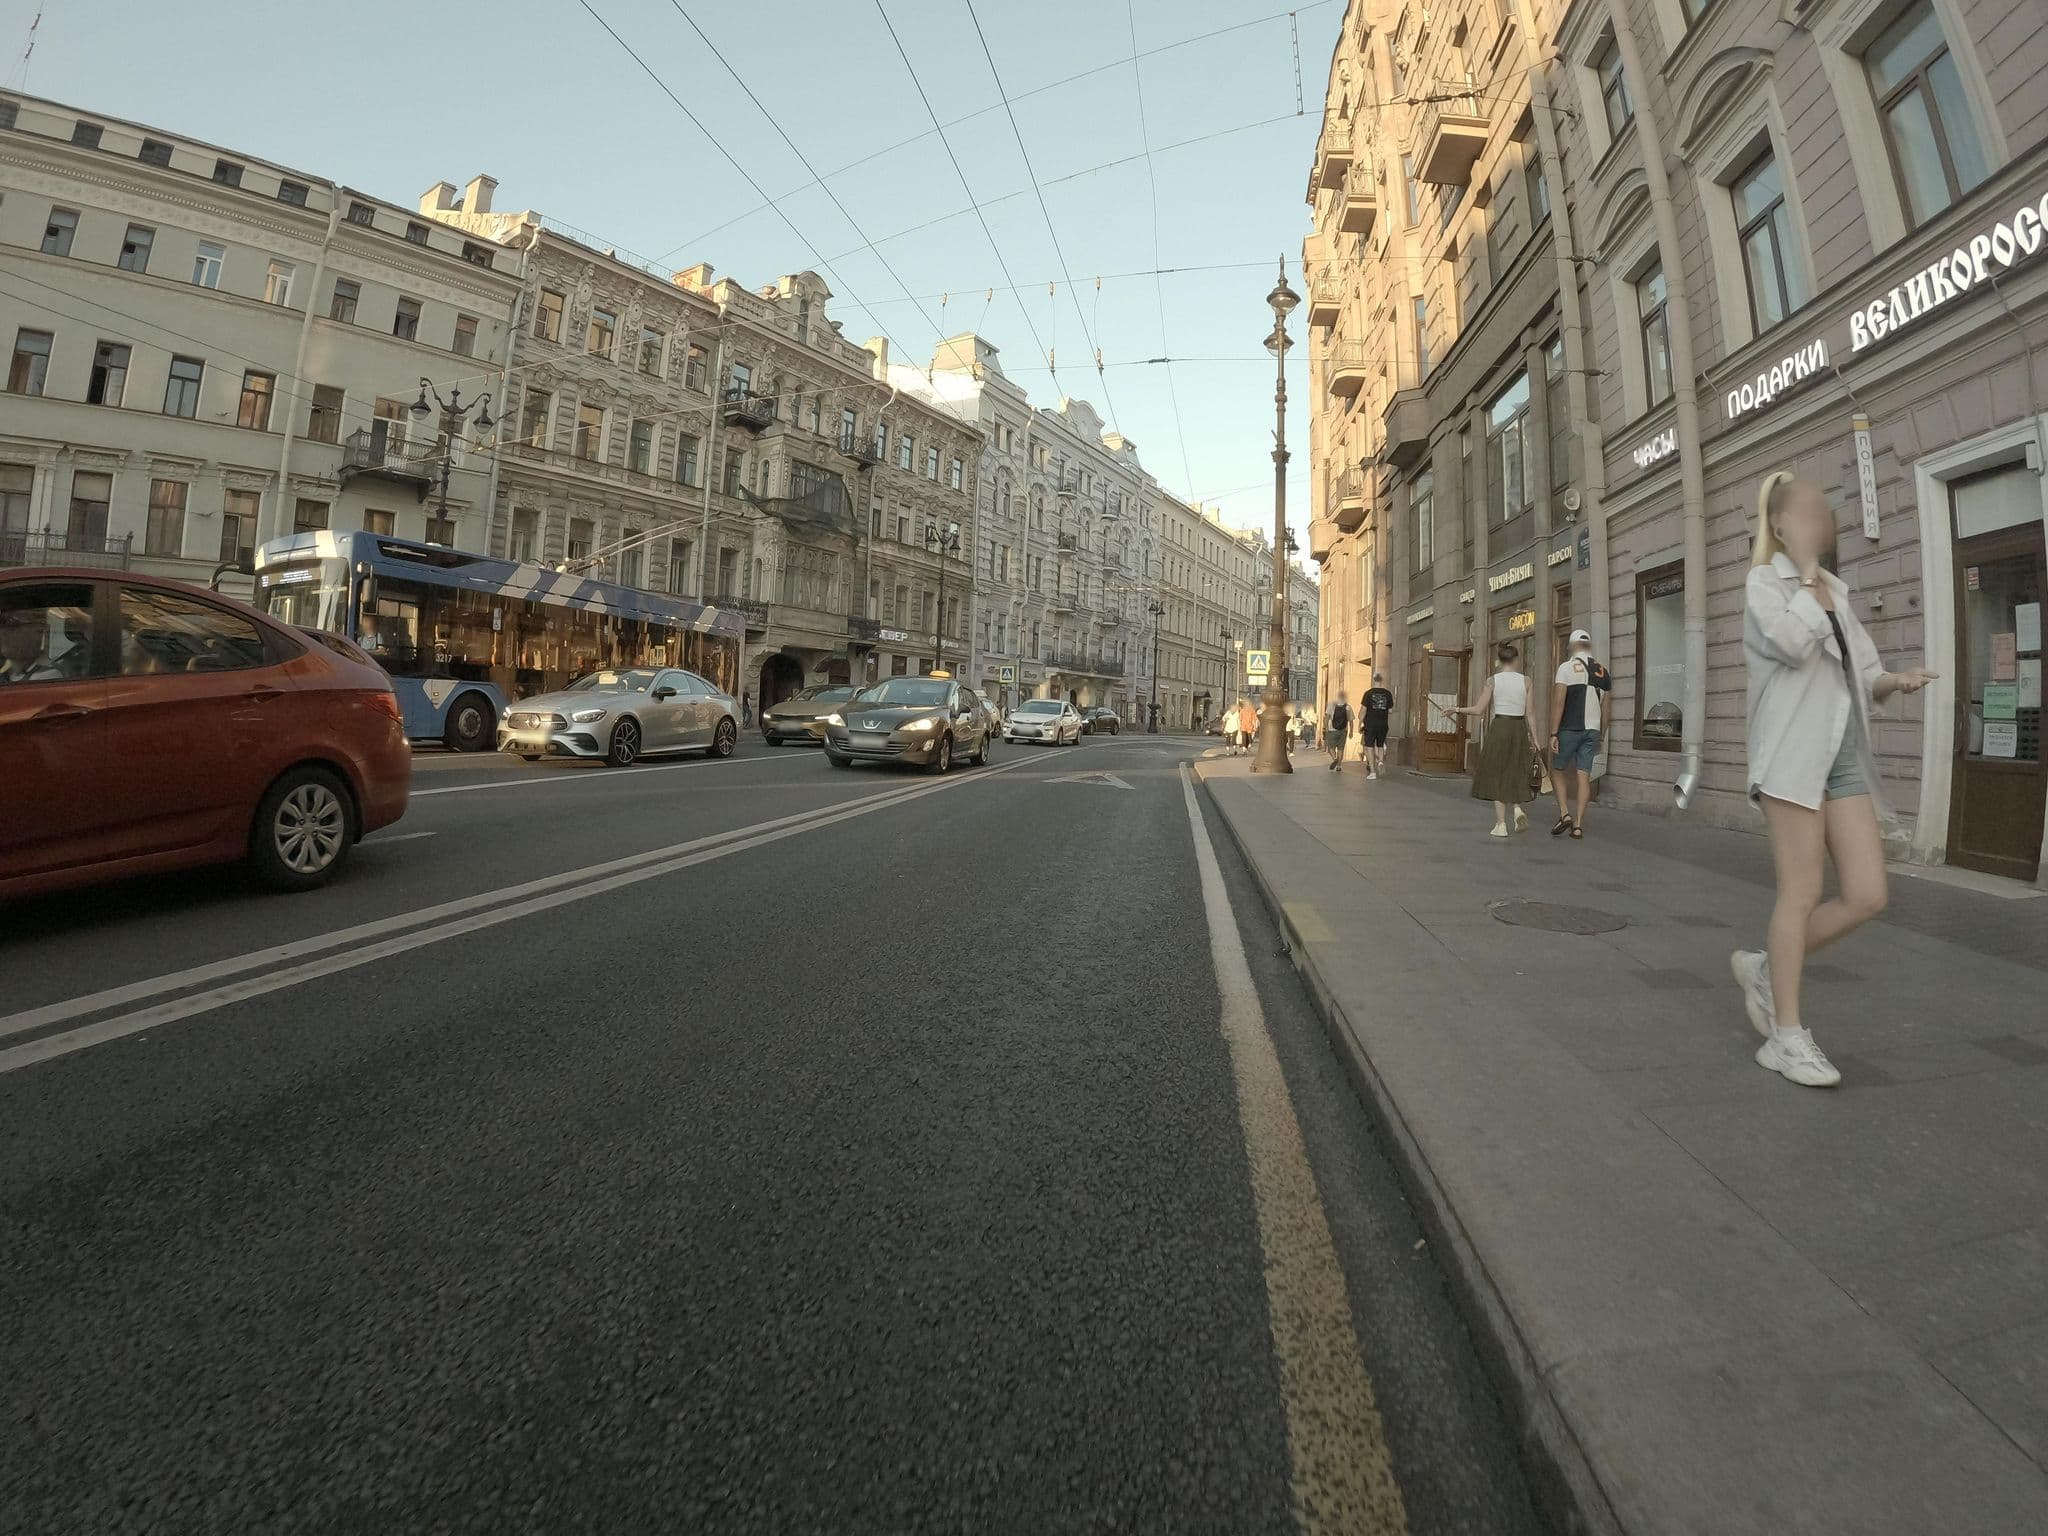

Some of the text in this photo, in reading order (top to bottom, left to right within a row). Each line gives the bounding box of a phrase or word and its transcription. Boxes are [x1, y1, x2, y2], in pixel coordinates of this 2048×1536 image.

[1728, 339, 1825, 419] ПОДАРКИ
[1633, 428, 1675, 467] ЧАСЫ
[1857, 436, 1878, 534] ПОЛИЦИЯ
[435, 653, 453, 663] 3217
